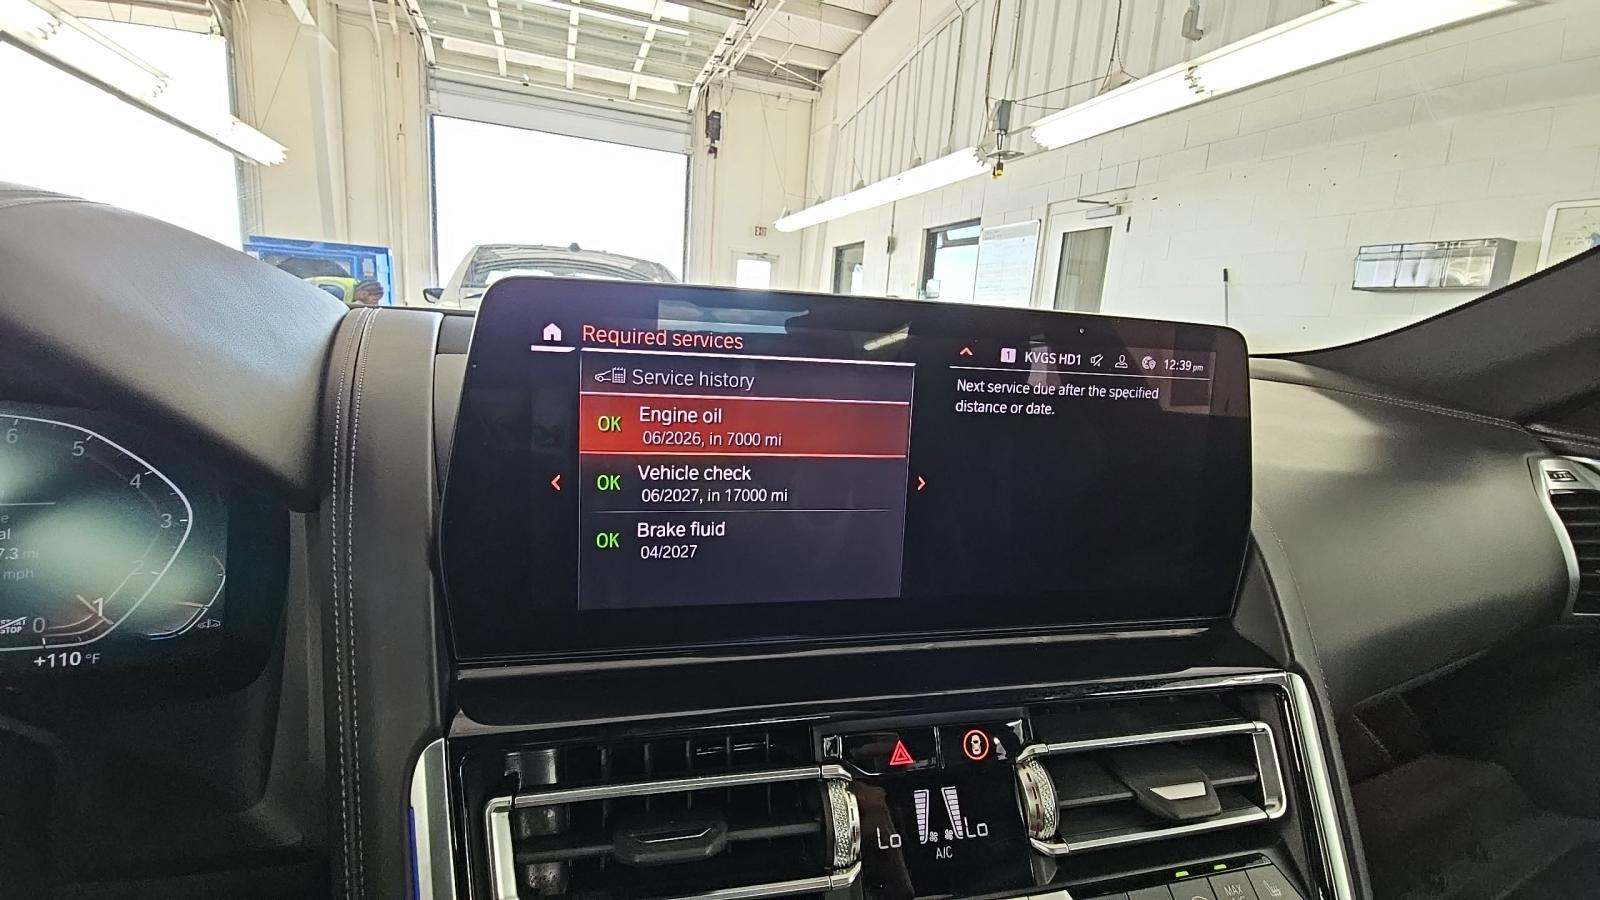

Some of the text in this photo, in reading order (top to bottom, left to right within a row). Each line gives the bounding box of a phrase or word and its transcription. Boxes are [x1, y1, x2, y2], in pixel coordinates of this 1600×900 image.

[582, 325, 744, 349] Required services
[1024, 352, 1057, 366] KVGS
[1058, 353, 1082, 366] HD1
[1164, 359, 1204, 373] 12:39 pm
[632, 368, 755, 391] Service history
[957, 379, 1159, 401] Next service due after the specified
[955, 400, 1055, 416] distance or date.
[597, 416, 622, 432] OK
[639, 406, 723, 427] Engine oil
[6, 428, 18, 443] 6
[642, 432, 783, 448] 06/2026, in 7000 mi
[72, 441, 84, 456] 5
[129, 473, 142, 489] 4
[638, 465, 752, 481] Vehicle check
[596, 474, 621, 491] OK
[641, 488, 789, 505] 06/2027, in 17000 mi
[160, 513, 172, 529] 3
[637, 521, 726, 538] Brake fluid
[596, 532, 620, 549] OK
[640, 544, 698, 560] 04/2027
[3, 568, 34, 581] mph
[32, 617, 46, 633] 0
[33, 651, 82, 668] +110
[964, 816, 989, 838] Lo
[876, 826, 902, 850] Lo
[936, 846, 953, 860] A/C
[1223, 884, 1243, 897] MAX
